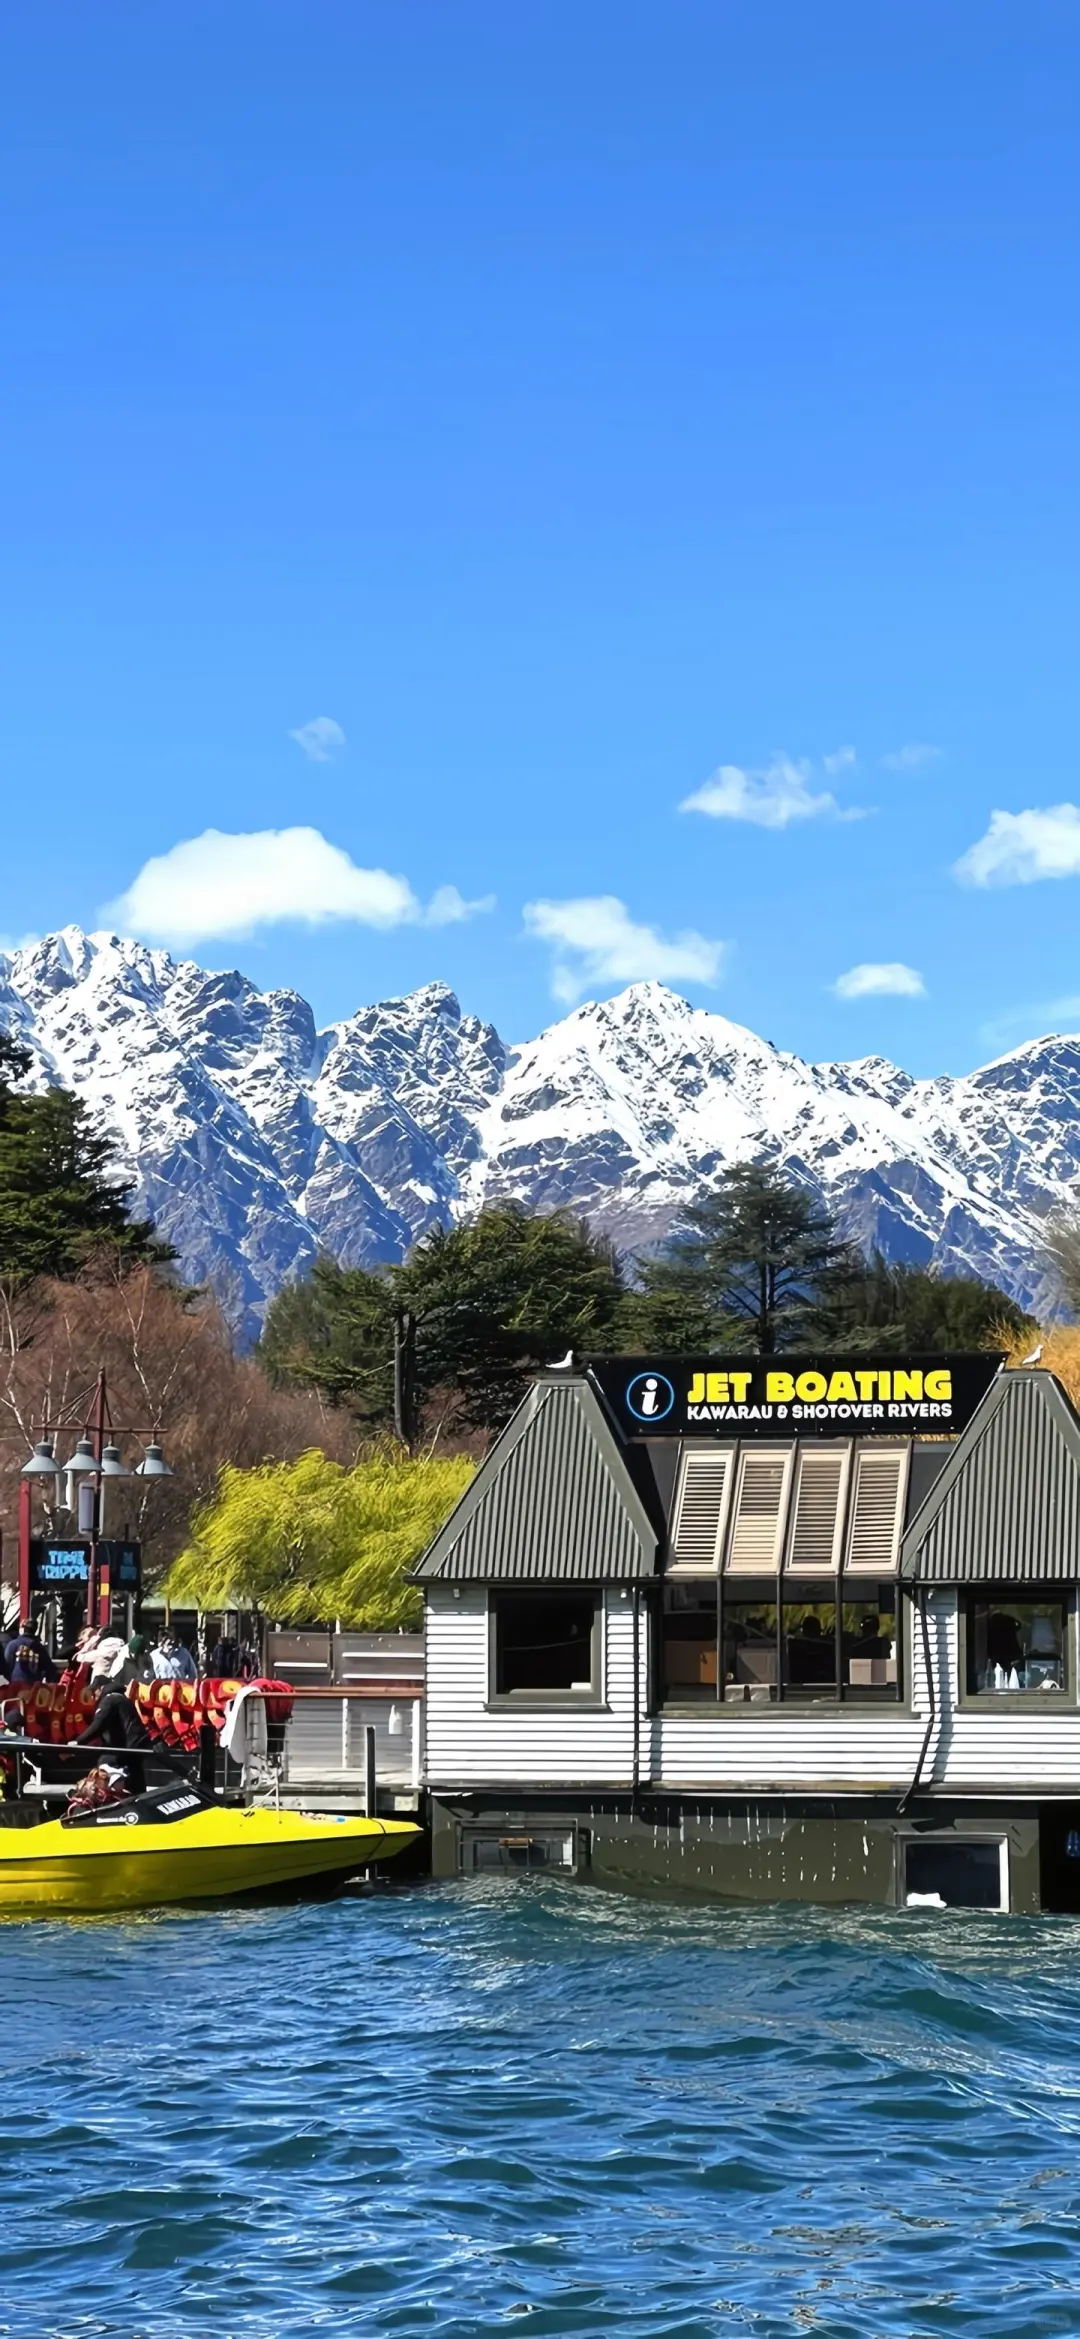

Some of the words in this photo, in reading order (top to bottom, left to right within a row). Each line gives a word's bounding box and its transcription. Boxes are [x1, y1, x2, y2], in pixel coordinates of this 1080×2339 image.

[687, 1372, 752, 1403] JET
[766, 1370, 952, 1402] BOATING
[687, 1405, 773, 1420] KAWARAU
[777, 1405, 788, 1419] &
[792, 1403, 884, 1419] SHOTOVER
[888, 1403, 952, 1418] RIVERS
[48, 1550, 85, 1566] TIME
